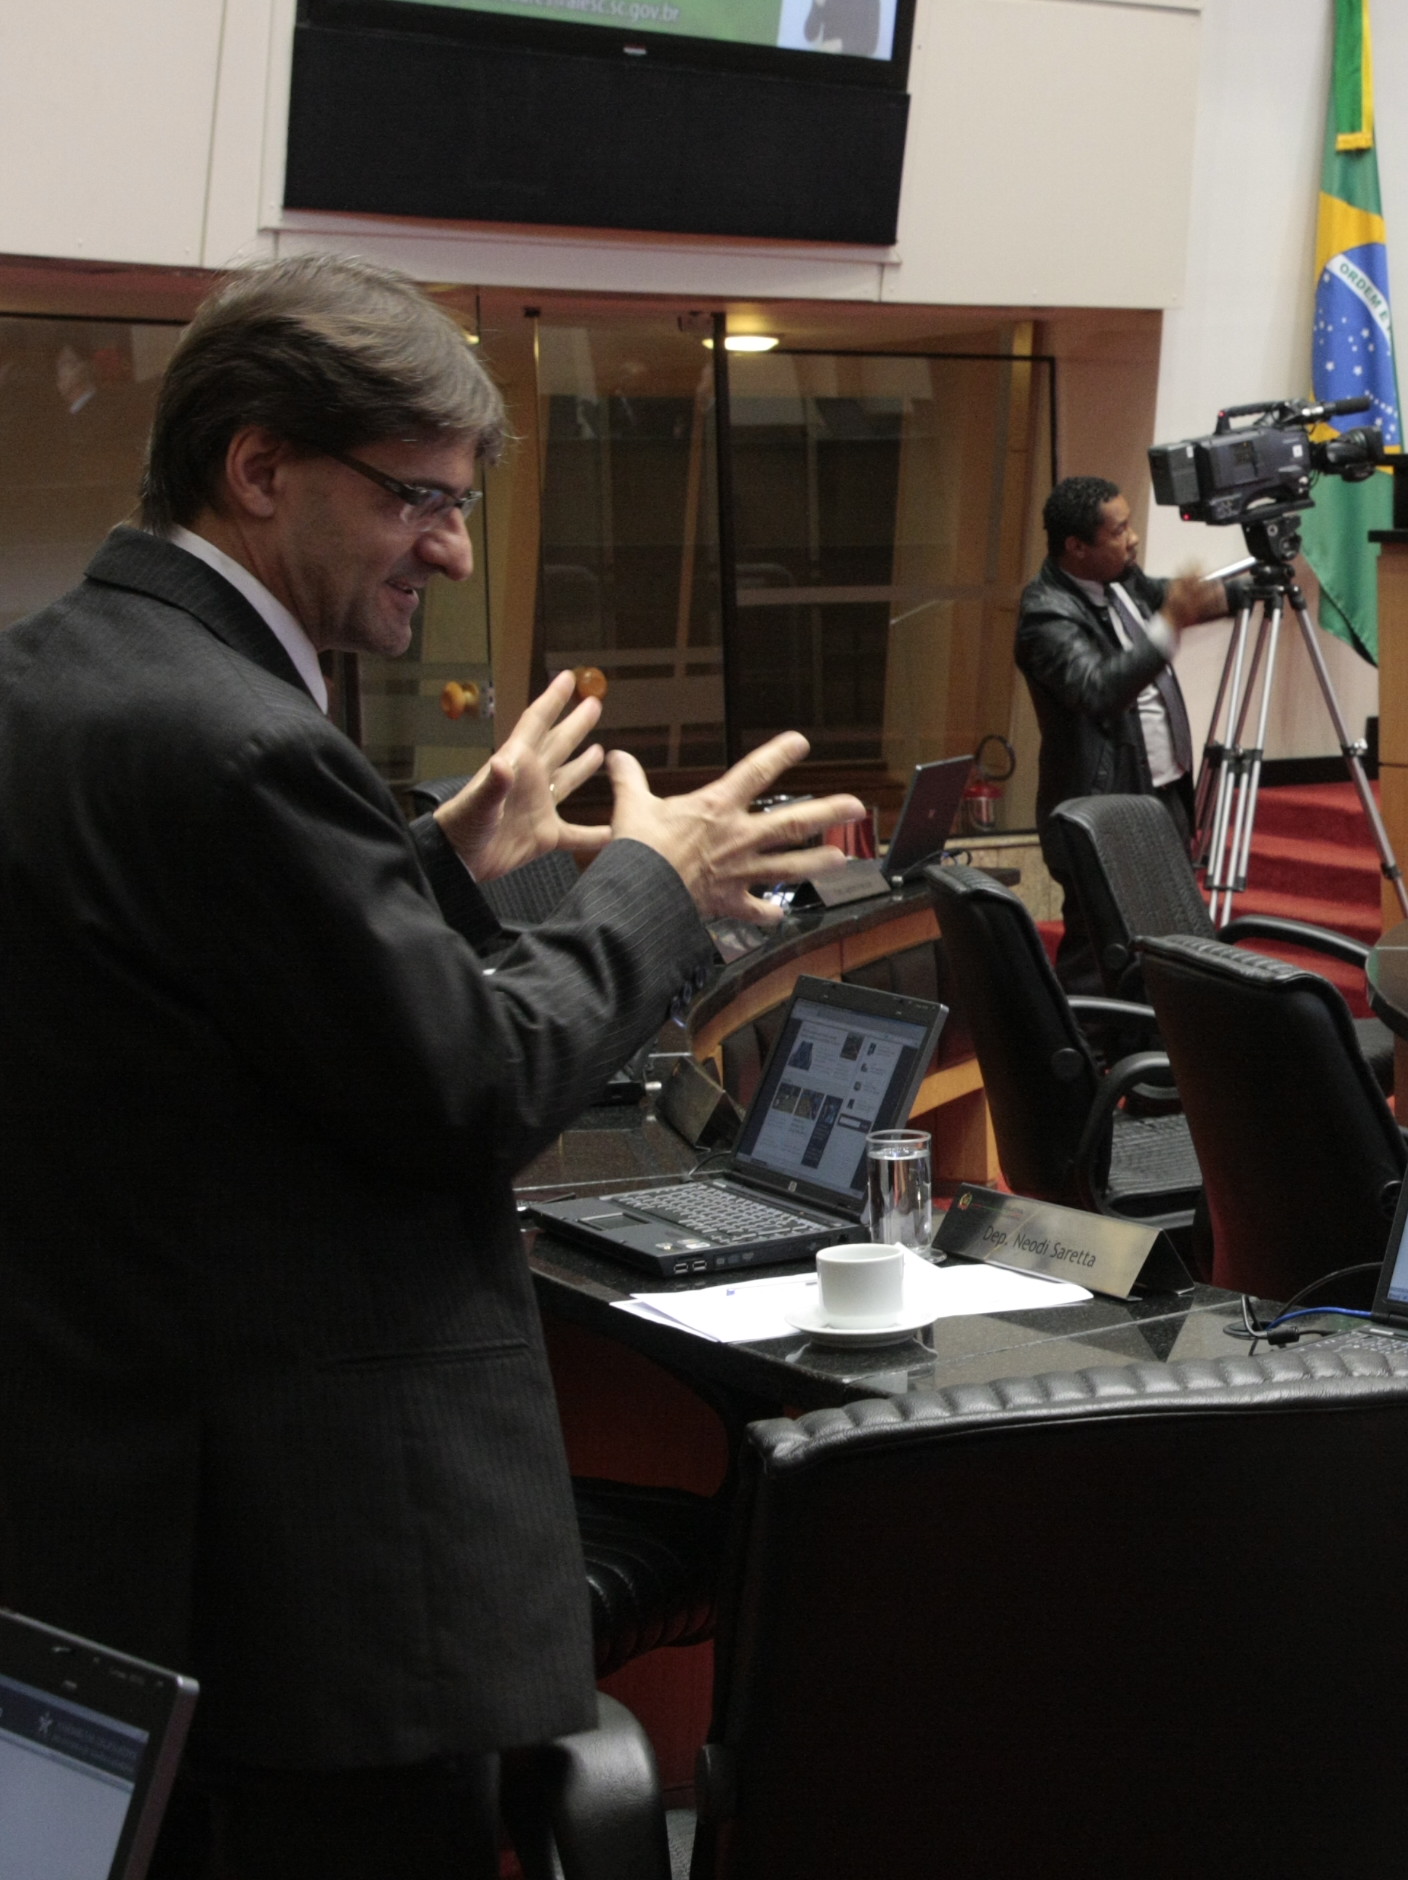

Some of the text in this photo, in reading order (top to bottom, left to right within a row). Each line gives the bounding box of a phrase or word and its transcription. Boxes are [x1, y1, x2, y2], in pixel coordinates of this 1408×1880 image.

[1339, 262, 1382, 309] ORDEM
[983, 1225, 1097, 1268] Dep. Neodi Saretta
